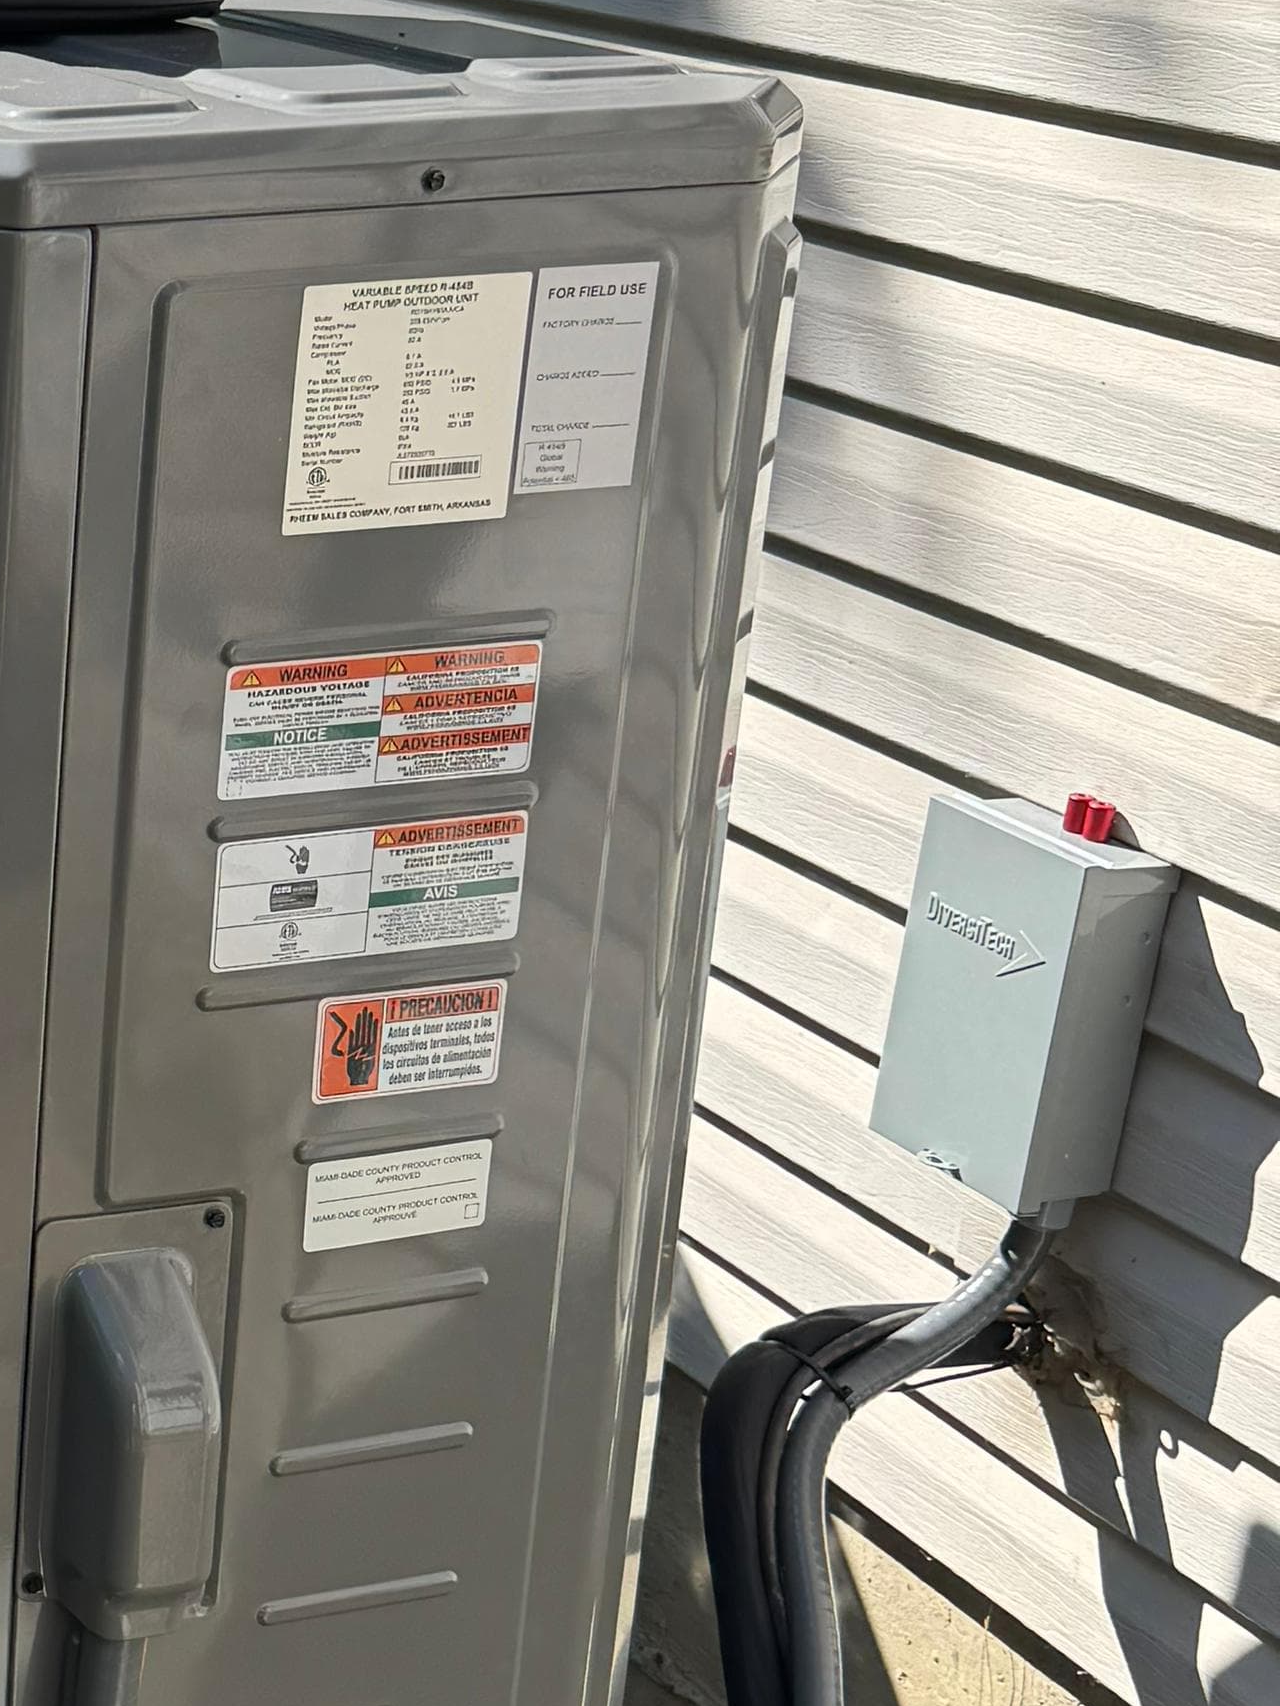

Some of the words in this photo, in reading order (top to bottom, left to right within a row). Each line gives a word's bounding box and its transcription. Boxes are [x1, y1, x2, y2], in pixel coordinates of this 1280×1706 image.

[352, 286, 402, 298] VARIABLE
[548, 287, 575, 299] FOR
[579, 285, 616, 297] FIELD
[620, 283, 647, 294] USE
[344, 300, 371, 311] HEAT
[373, 299, 401, 309] PUMP
[404, 295, 453, 307] OUTDOOR
[446, 499, 491, 510] ARKANSAS
[435, 651, 505, 669] WARNING
[279, 664, 348, 682] WARNING
[247, 686, 316, 698] HAZARDOUS
[320, 681, 370, 691] VOLTAGE
[414, 688, 518, 709] ADVERTENCIA
[273, 727, 328, 745] NOTICE
[400, 727, 531, 751] ADVERTISSEMENT
[398, 818, 521, 843] ADVERTISSEMENT
[423, 886, 458, 900] AVIS
[399, 991, 485, 1018] PRECAUCION
[388, 1026, 410, 1038] Antes
[412, 1024, 421, 1035] de
[424, 1022, 443, 1035] tener
[445, 1020, 471, 1032] acceso
[473, 1019, 479, 1029] a
[480, 1016, 492, 1028] los
[382, 1040, 428, 1056] dispositivos
[430, 1035, 472, 1049] terminales,
[474, 1032, 495, 1044] todos
[383, 1058, 394, 1070] los
[397, 1054, 430, 1068] circuitos
[431, 1053, 440, 1063] de
[443, 1047, 492, 1063] alimentación
[389, 1073, 412, 1085] deben
[414, 1071, 425, 1082] ser
[428, 1064, 483, 1080] interrumpidos.
[315, 1170, 364, 1183] MIAMI-DADE
[365, 1165, 400, 1177] COUNTY
[402, 1158, 442, 1171] PRODUCT
[444, 1152, 483, 1164] CONTROL
[375, 1171, 421, 1185] APPROVED
[312, 1209, 361, 1223] MIAMI-DADE
[363, 1204, 396, 1217] COUNTY
[398, 1198, 438, 1211] PRODUCT
[440, 1192, 479, 1205] CONTROL
